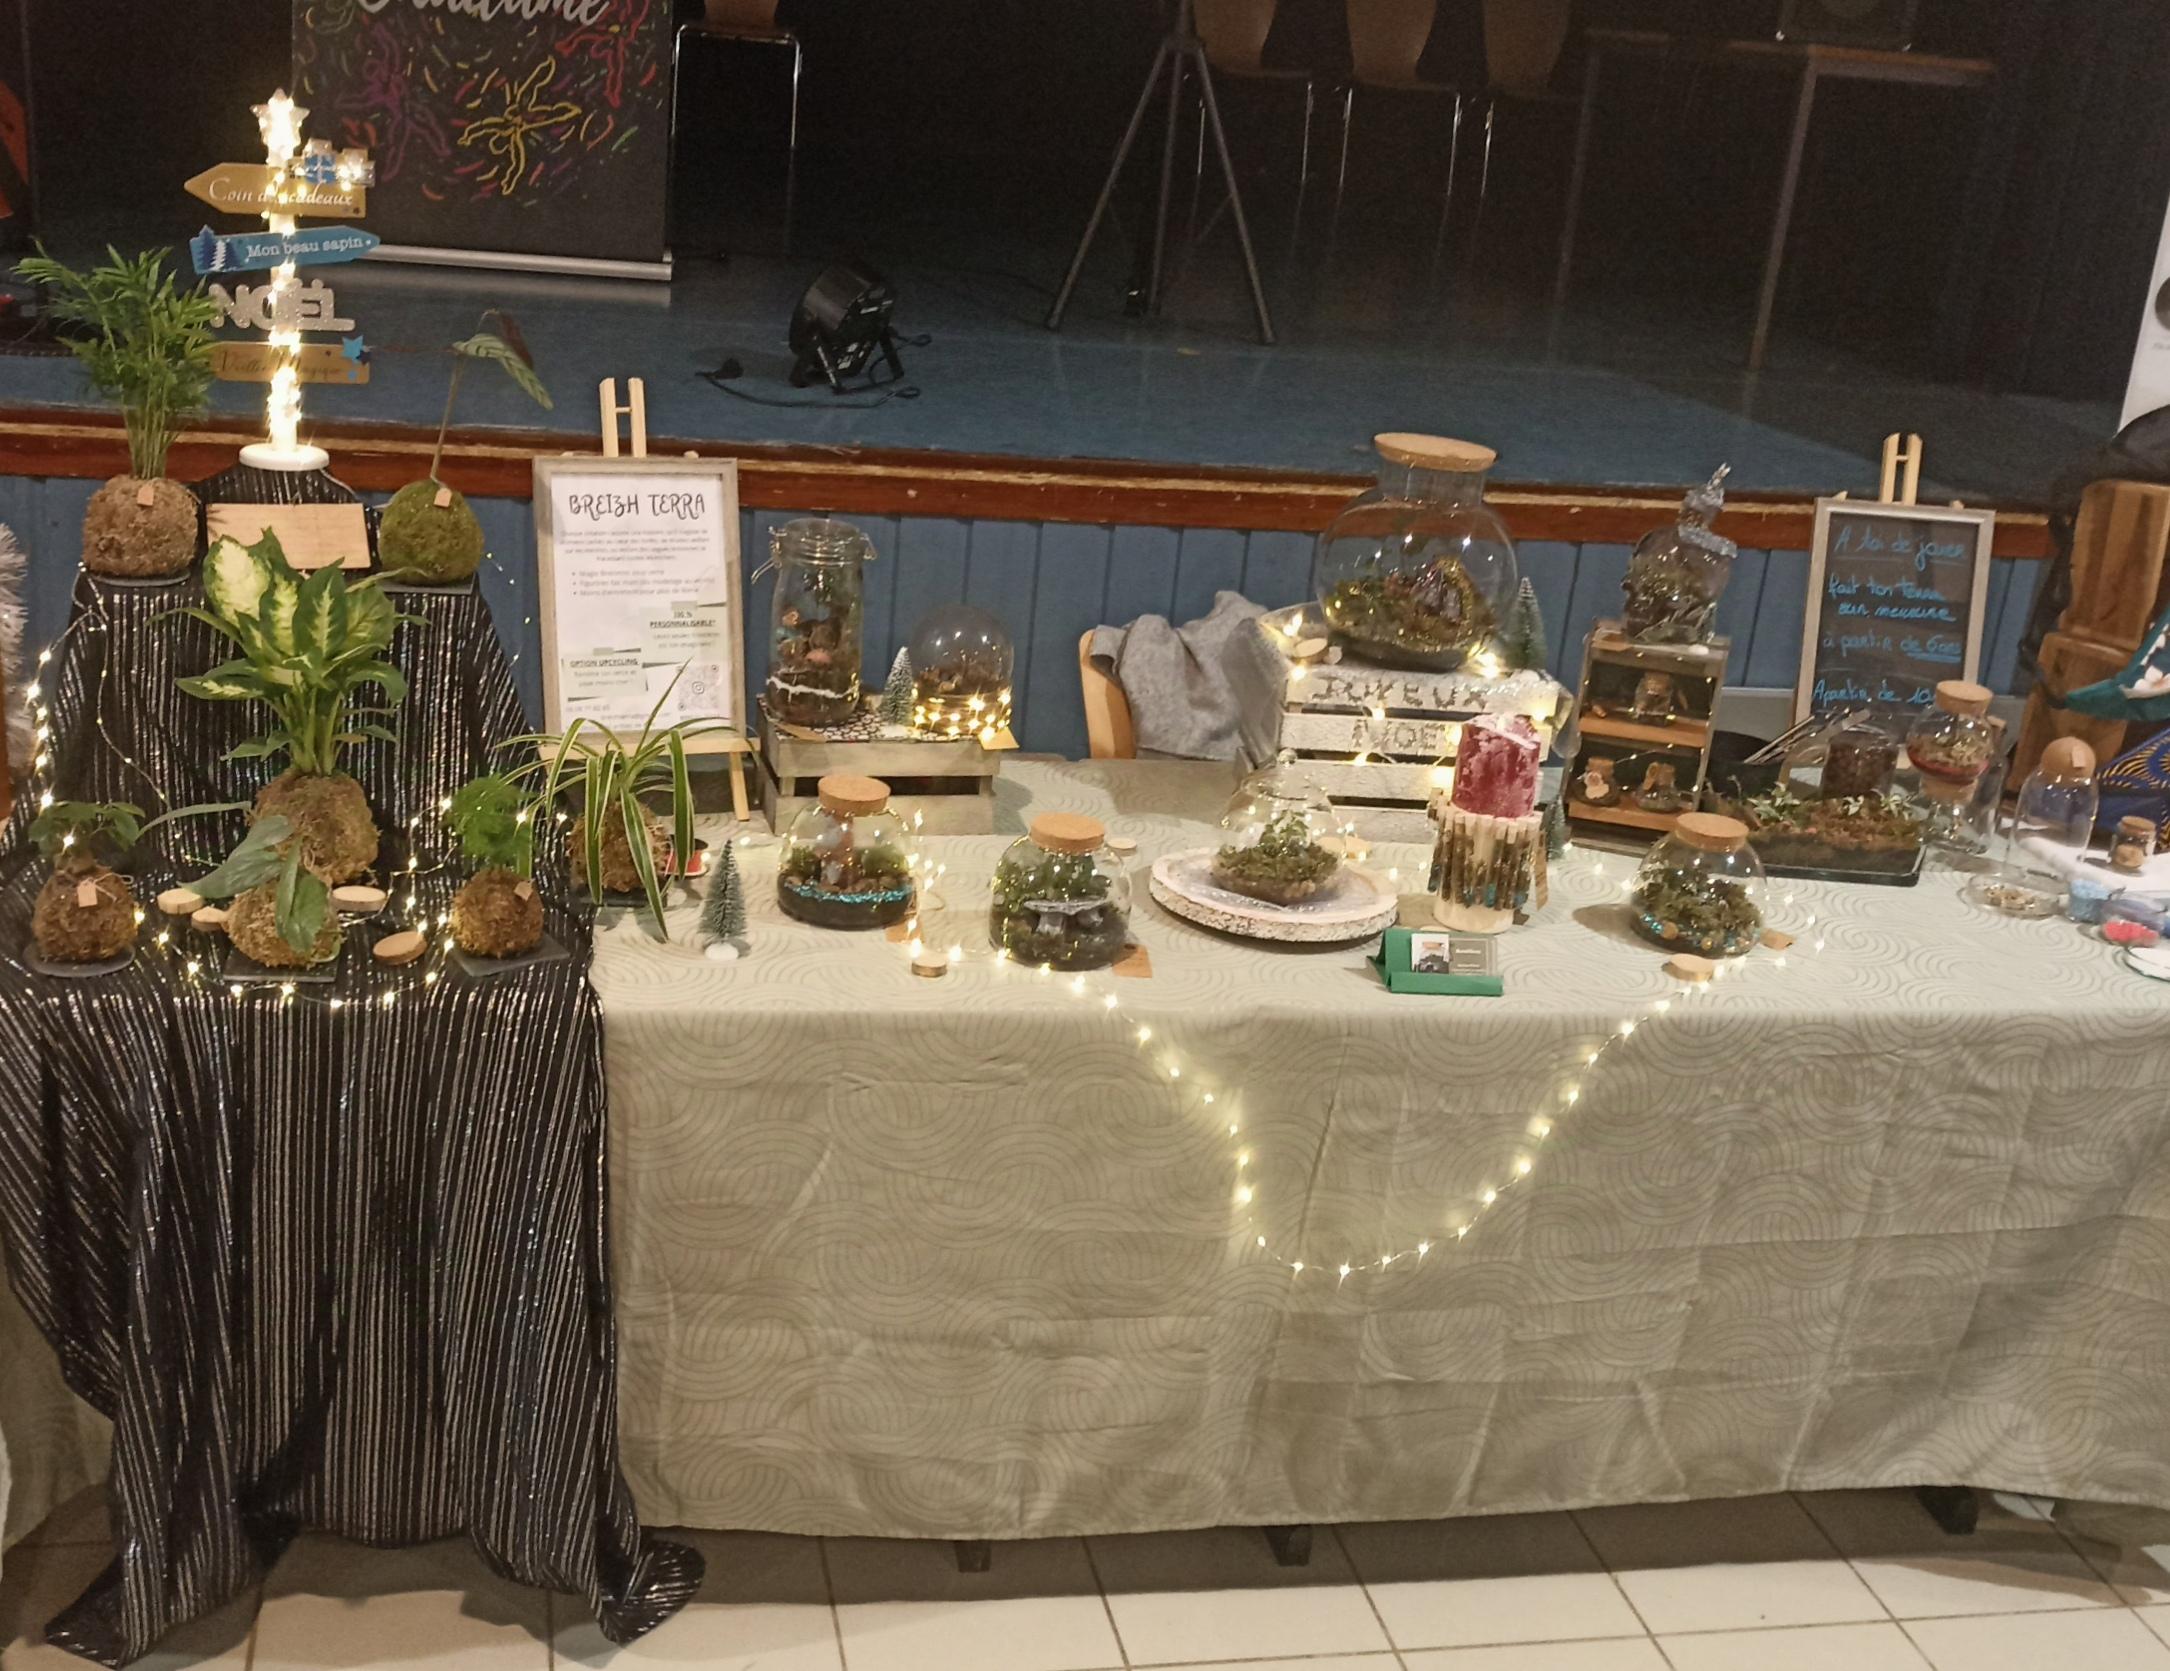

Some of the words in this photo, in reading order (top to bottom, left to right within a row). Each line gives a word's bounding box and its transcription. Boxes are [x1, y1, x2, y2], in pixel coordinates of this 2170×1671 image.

[209, 178, 252, 201] Coin
[246, 245, 280, 258] Mon
[284, 242, 319, 254] beau
[323, 236, 363, 252] sapin
[569, 493, 640, 521] BREIZH
[648, 492, 706, 520] TERRA
[1867, 575, 1893, 597] ton
[1906, 687, 1936, 704] 10
